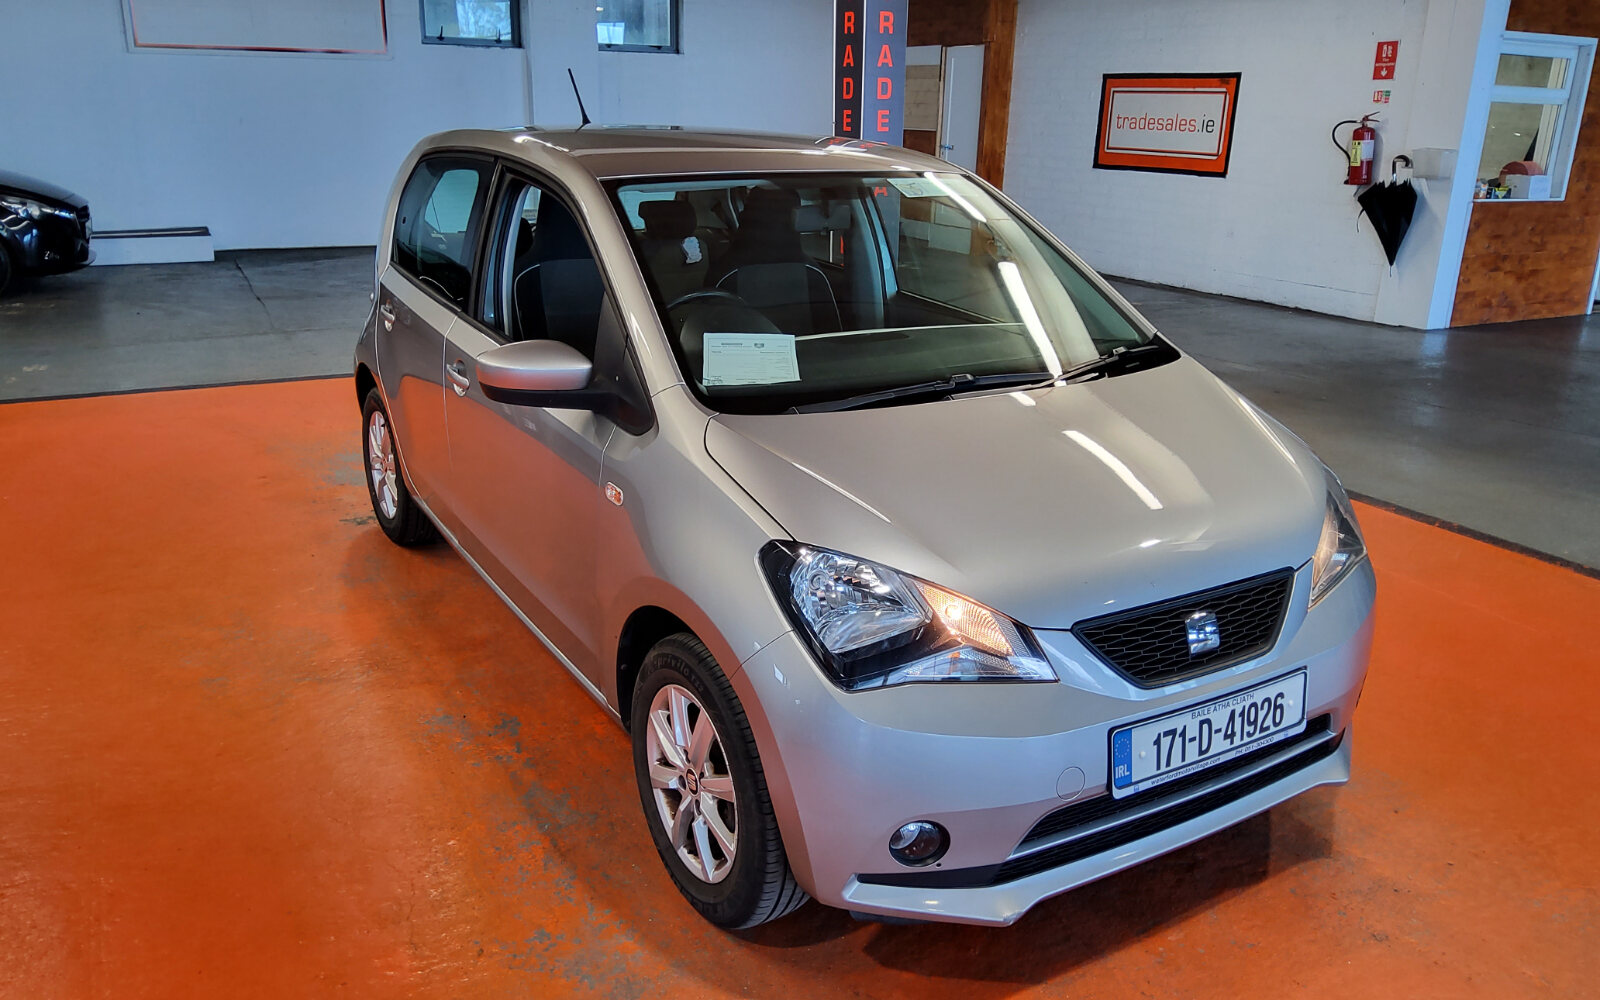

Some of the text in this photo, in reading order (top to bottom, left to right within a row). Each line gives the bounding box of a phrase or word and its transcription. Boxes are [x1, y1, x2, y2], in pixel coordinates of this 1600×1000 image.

[1116, 112, 1215, 133] tradesales.ie
[1191, 706, 1212, 720] BAILE
[1231, 692, 1255, 706] CLIATH
[1153, 692, 1285, 772] 171-D-41926
[1115, 763, 1130, 779] IRL
